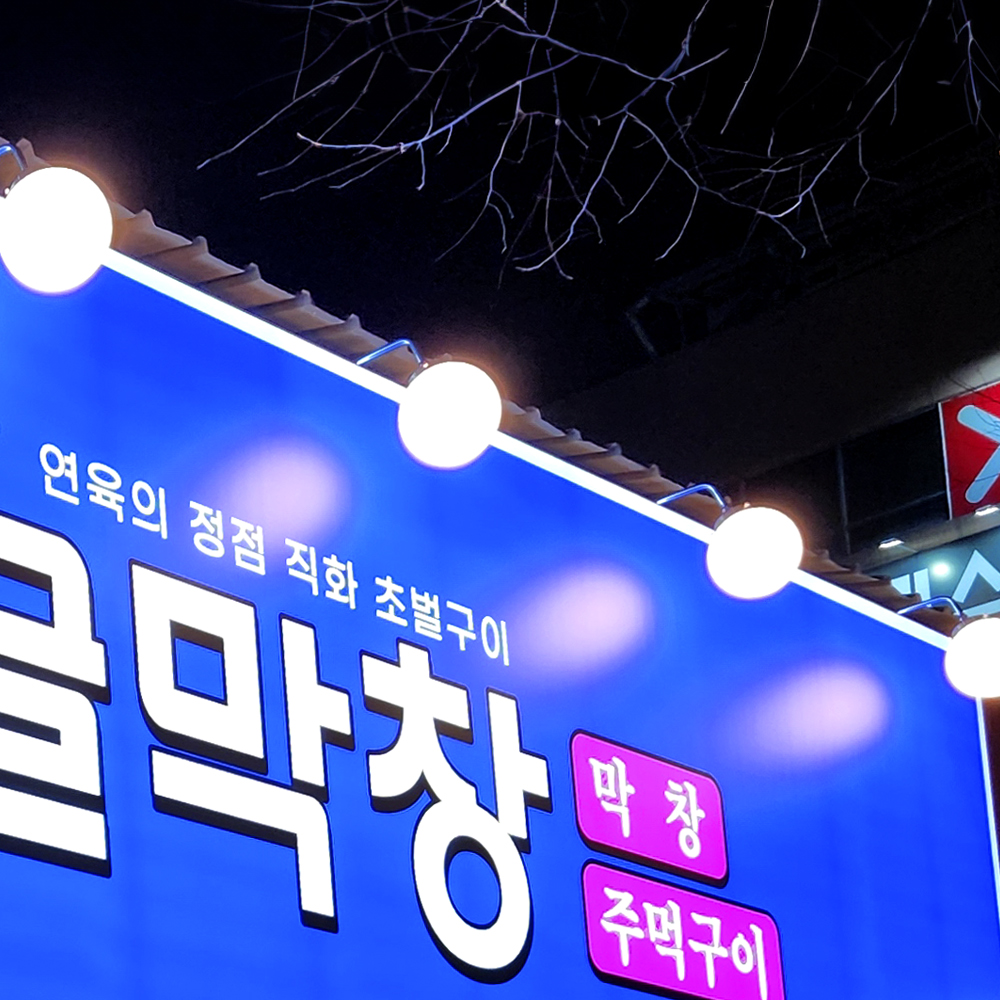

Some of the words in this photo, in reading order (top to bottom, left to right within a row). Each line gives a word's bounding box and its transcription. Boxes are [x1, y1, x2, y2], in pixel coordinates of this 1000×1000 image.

[39, 442, 168, 539] 연육의
[189, 501, 266, 575] 정점
[285, 538, 358, 610] 직화
[375, 575, 510, 666] 초벌구이
